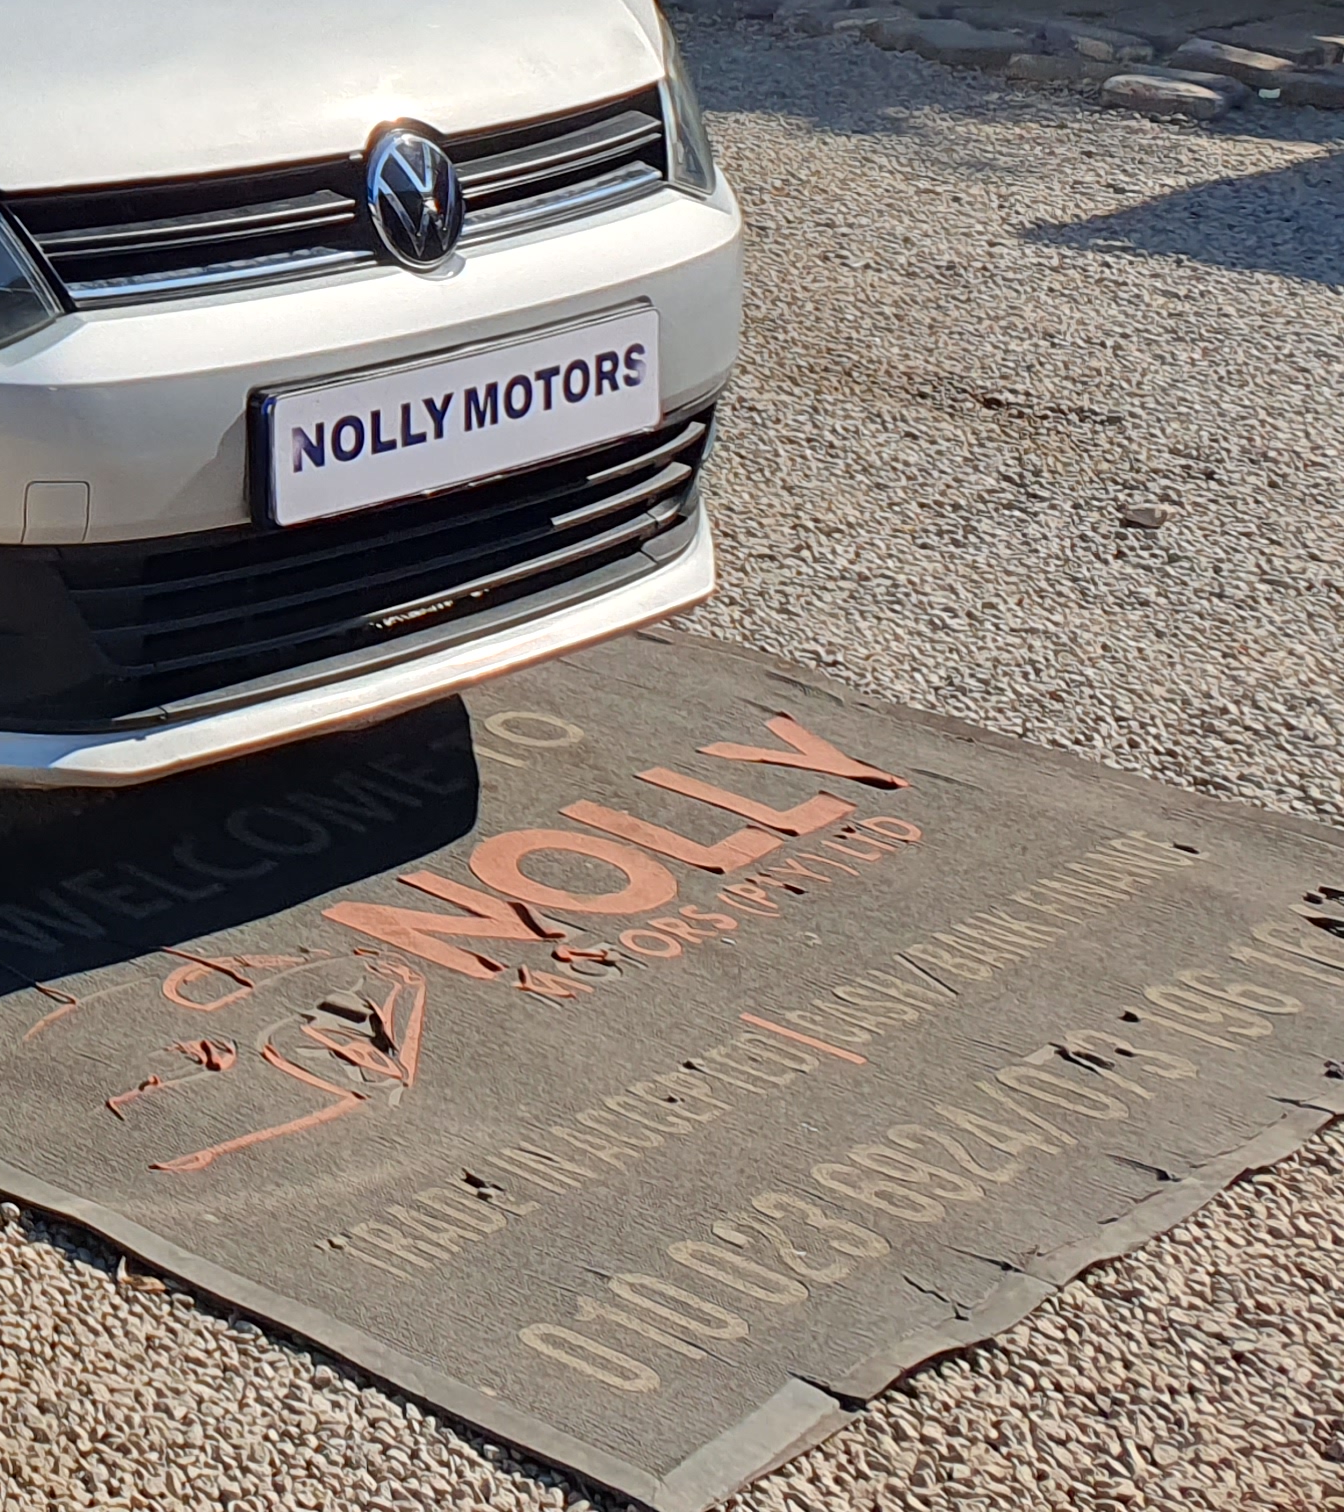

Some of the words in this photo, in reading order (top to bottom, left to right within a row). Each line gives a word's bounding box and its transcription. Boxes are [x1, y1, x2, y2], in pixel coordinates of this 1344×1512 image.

[292, 392, 454, 473] NOLLY
[462, 342, 647, 432] MOTORS
[321, 710, 912, 979] NOLLY
[484, 1140, 598, 1195] IN
[549, 1030, 820, 1172] ACCEPTED
[518, 1271, 751, 1393] 010
[666, 1192, 892, 1306] 023
[1117, 968, 1304, 1052] 196
